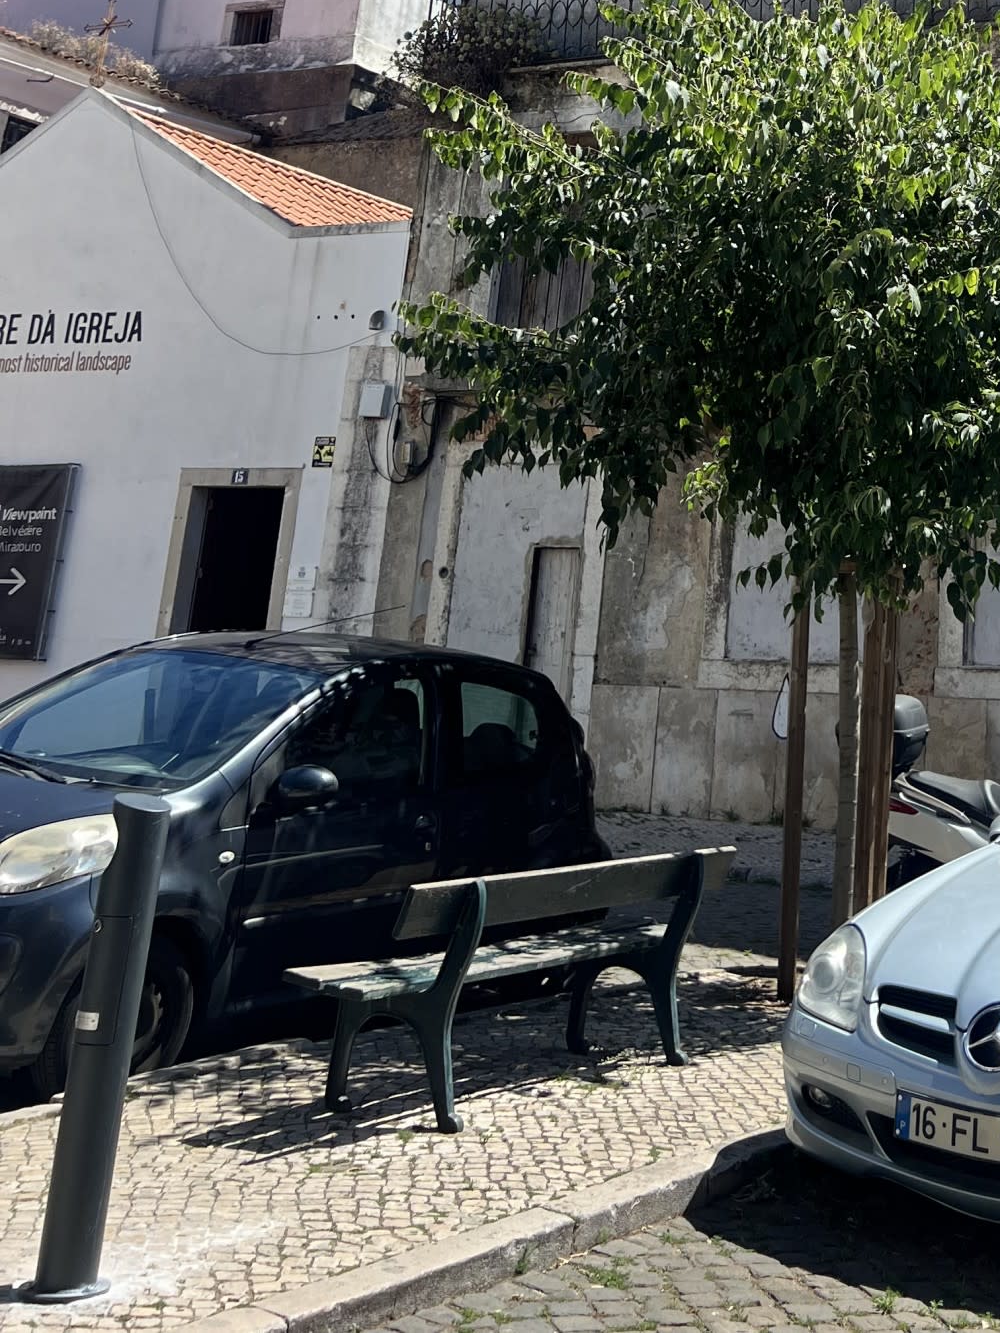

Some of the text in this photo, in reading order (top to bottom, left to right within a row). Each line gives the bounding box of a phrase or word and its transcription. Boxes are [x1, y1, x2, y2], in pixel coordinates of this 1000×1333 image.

[64, 310, 142, 344] IGREJA
[23, 351, 75, 372] historical
[76, 351, 132, 375] landscape
[234, 471, 244, 483] 15
[2, 506, 57, 523] Viewpoint
[900, 1121, 906, 1130] P
